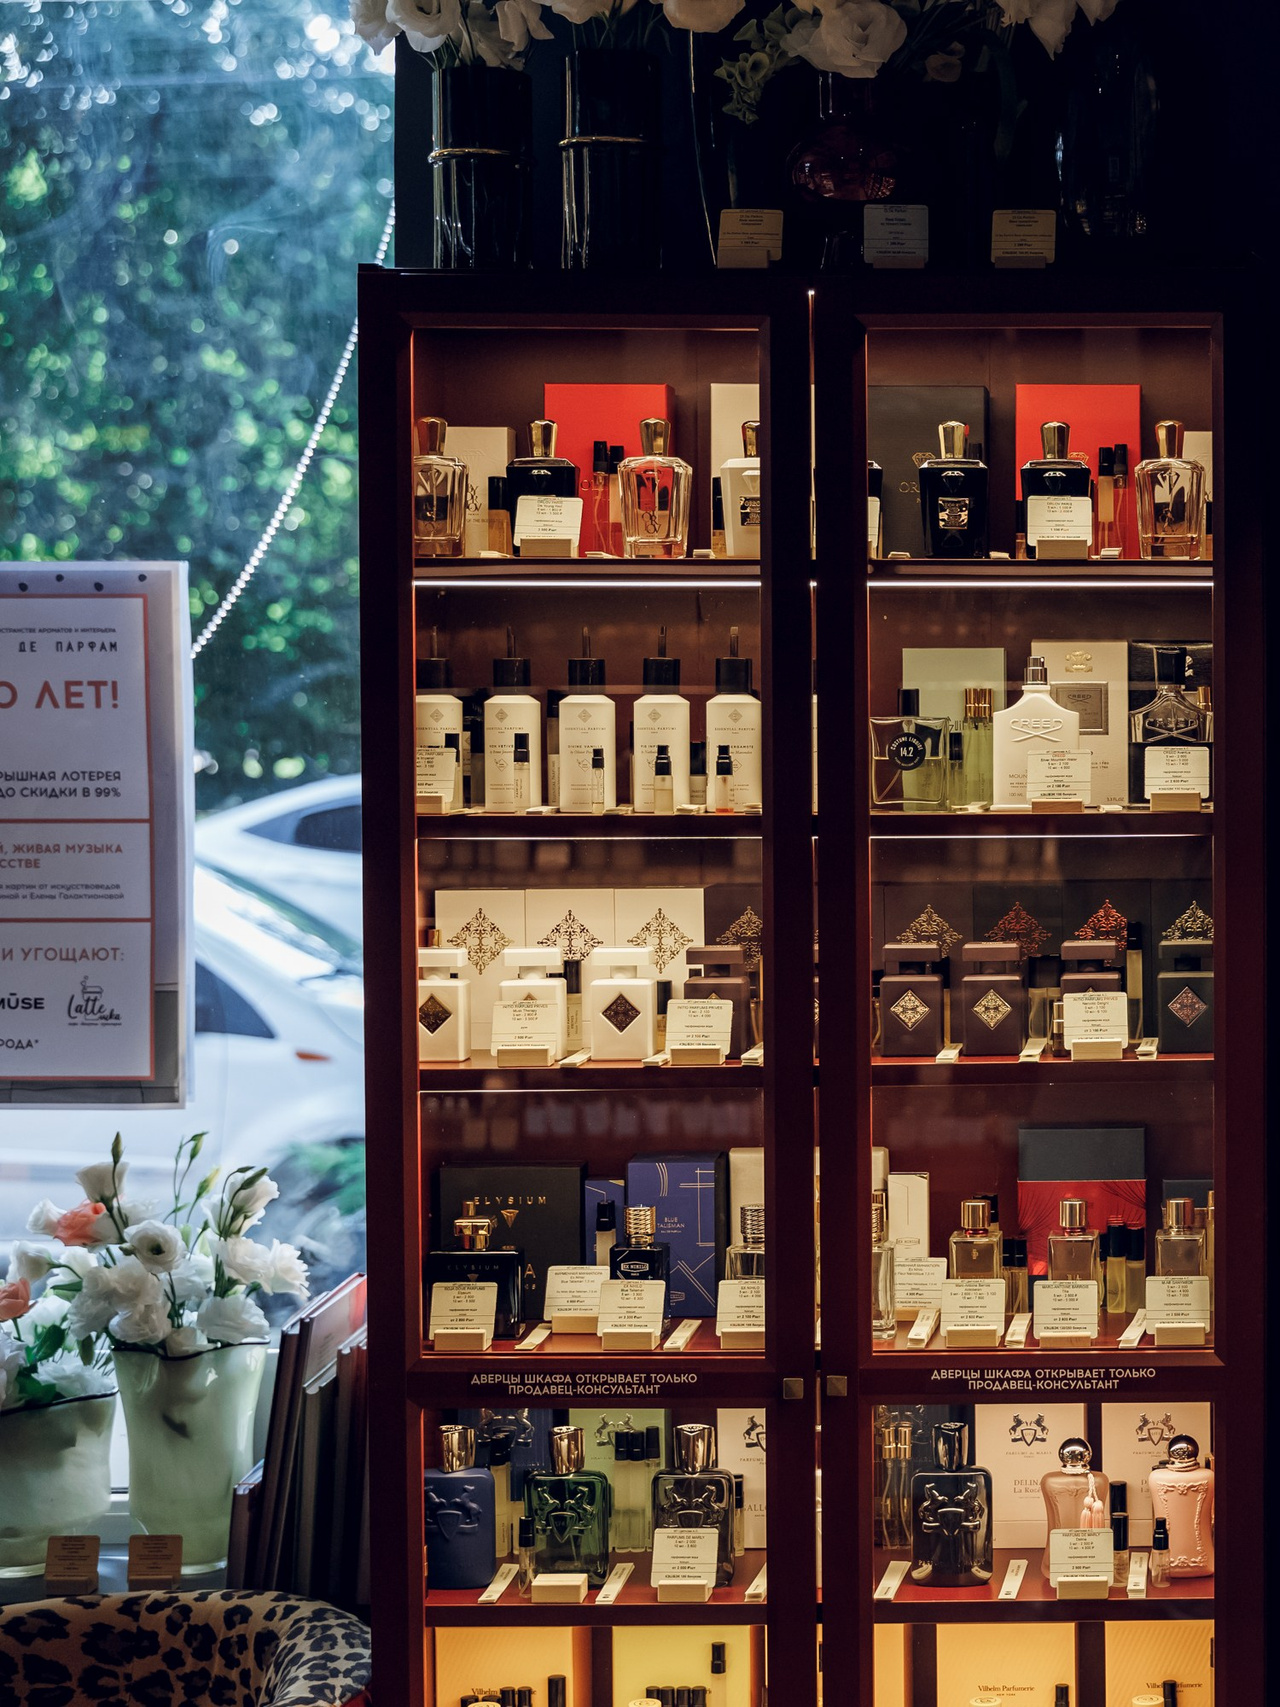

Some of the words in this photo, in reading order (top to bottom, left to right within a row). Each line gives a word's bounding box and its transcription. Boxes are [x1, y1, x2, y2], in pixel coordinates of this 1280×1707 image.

[18, 641, 37, 653] ДЕ
[55, 641, 118, 653] ПАРФАМ
[35, 680, 119, 709] ЛЕТ!
[1010, 719, 1063, 733] CREED
[900, 746, 914, 757] 14.2
[61, 771, 121, 782] ЛОТЕРЕЯ
[20, 787, 77, 799] СКИДКИ
[82, 787, 91, 797] В
[95, 787, 121, 798] 99%
[12, 843, 61, 854] ЖИВАЯ
[65, 843, 123, 854] МУЗЫКА
[2, 947, 14, 961] И
[21, 947, 124, 962] УГОЩАЮТ:
[474, 1196, 546, 1205] ELYSIUM
[471, 1375, 521, 1385] ДВЕРЦЫ
[524, 1374, 572, 1384] ШКАФА
[576, 1374, 647, 1384] ОТКРЫВАЕТ
[650, 1374, 698, 1384] ТОЛЬКО
[931, 1370, 981, 1380] ДВЕРЦЫ
[984, 1369, 1032, 1379] ШКАФА
[1035, 1369, 1106, 1379] ОТКРЫВАЕТ
[1110, 1368, 1156, 1378] ТОЛЬКО
[508, 1385, 661, 1395] ПРОДАВЕЦ-КОНСУЛЬТАНТ
[968, 1380, 1119, 1390] ПРОДАВЕЦ-КОНСУЛЬТАНТ
